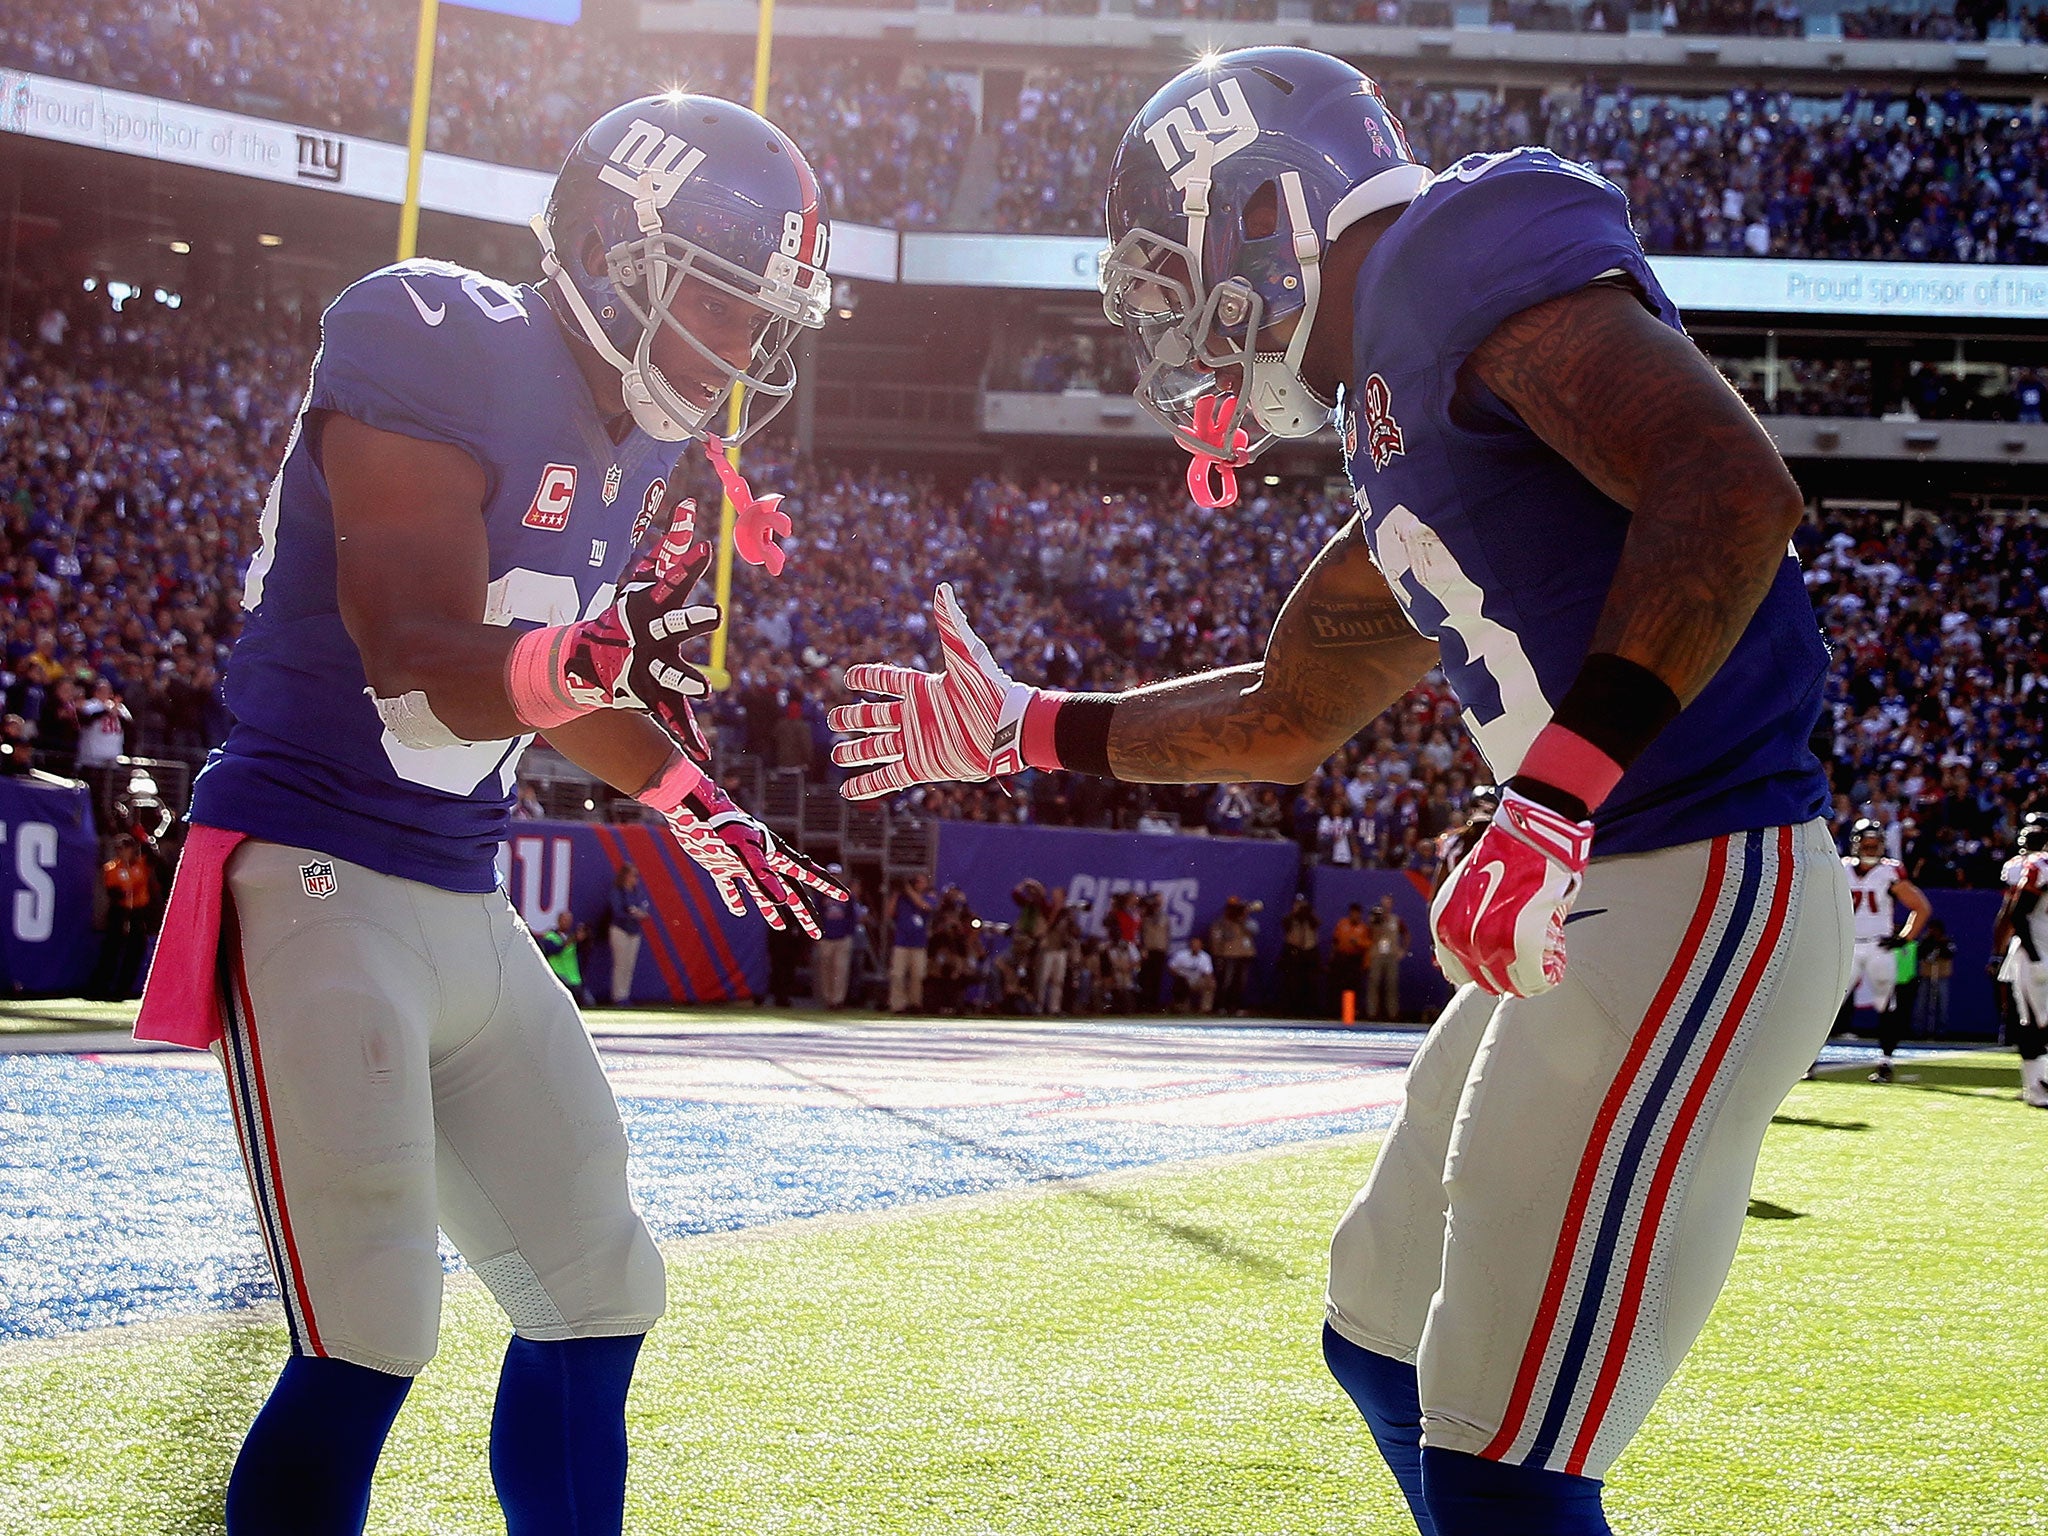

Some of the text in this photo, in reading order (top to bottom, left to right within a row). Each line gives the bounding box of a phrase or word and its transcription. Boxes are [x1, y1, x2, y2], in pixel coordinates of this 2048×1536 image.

[103, 109, 202, 150] sponsor
[211, 124, 234, 157] of
[242, 129, 282, 168] the
[1786, 270, 2048, 307] Proud sponsor of the
[536, 469, 574, 514] C
[647, 484, 665, 515] 90
[0, 821, 59, 943] S
[305, 874, 334, 894] NFL
